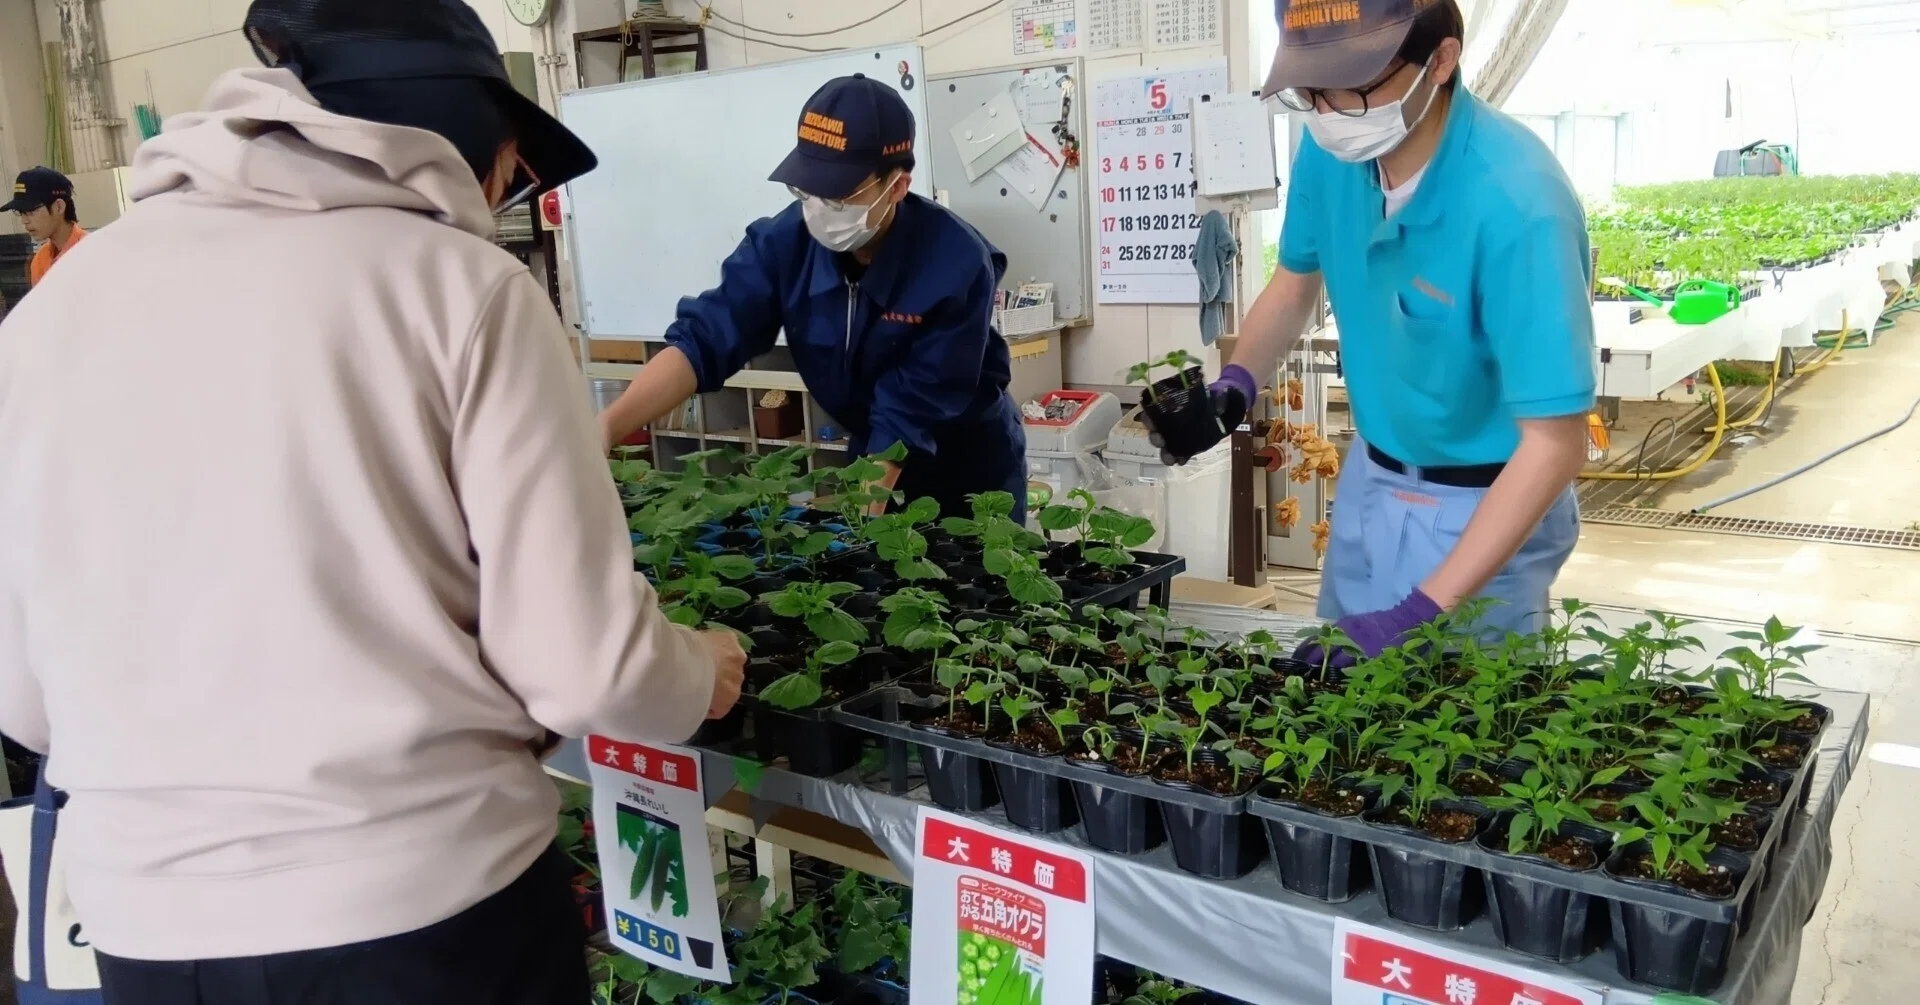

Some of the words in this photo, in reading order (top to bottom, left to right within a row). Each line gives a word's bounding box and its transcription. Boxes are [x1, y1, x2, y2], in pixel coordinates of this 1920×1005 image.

[1151, 84, 1166, 109] 5
[1136, 127, 1147, 136] 28
[1154, 125, 1164, 135] 29
[1172, 124, 1182, 133] 30
[1102, 157, 1111, 173] 3
[1119, 156, 1129, 171] 4
[1138, 155, 1146, 170] 5
[1155, 154, 1164, 169] 6
[1173, 152, 1182, 168] 7
[1101, 187, 1115, 203] 10
[1118, 187, 1131, 202] 11
[1135, 185, 1150, 201] 12
[1153, 184, 1167, 200] 13
[1171, 183, 1185, 199] 14
[1102, 217, 1116, 232] 17
[1118, 216, 1133, 231] 18
[1136, 215, 1150, 230] 19
[1153, 215, 1168, 230] 20
[1171, 214, 1185, 229] 21
[1102, 246, 1110, 254] 24
[1118, 246, 1133, 261] 25
[1136, 245, 1151, 260] 26
[1153, 245, 1168, 260] 27
[1171, 244, 1186, 260] 28
[1188, 244, 1196, 259] 2
[1102, 261, 1110, 269] 31
[604, 745, 678, 783] 大特価
[947, 836, 1055, 890] 大特価
[981, 894, 1043, 940] 五角オクラ
